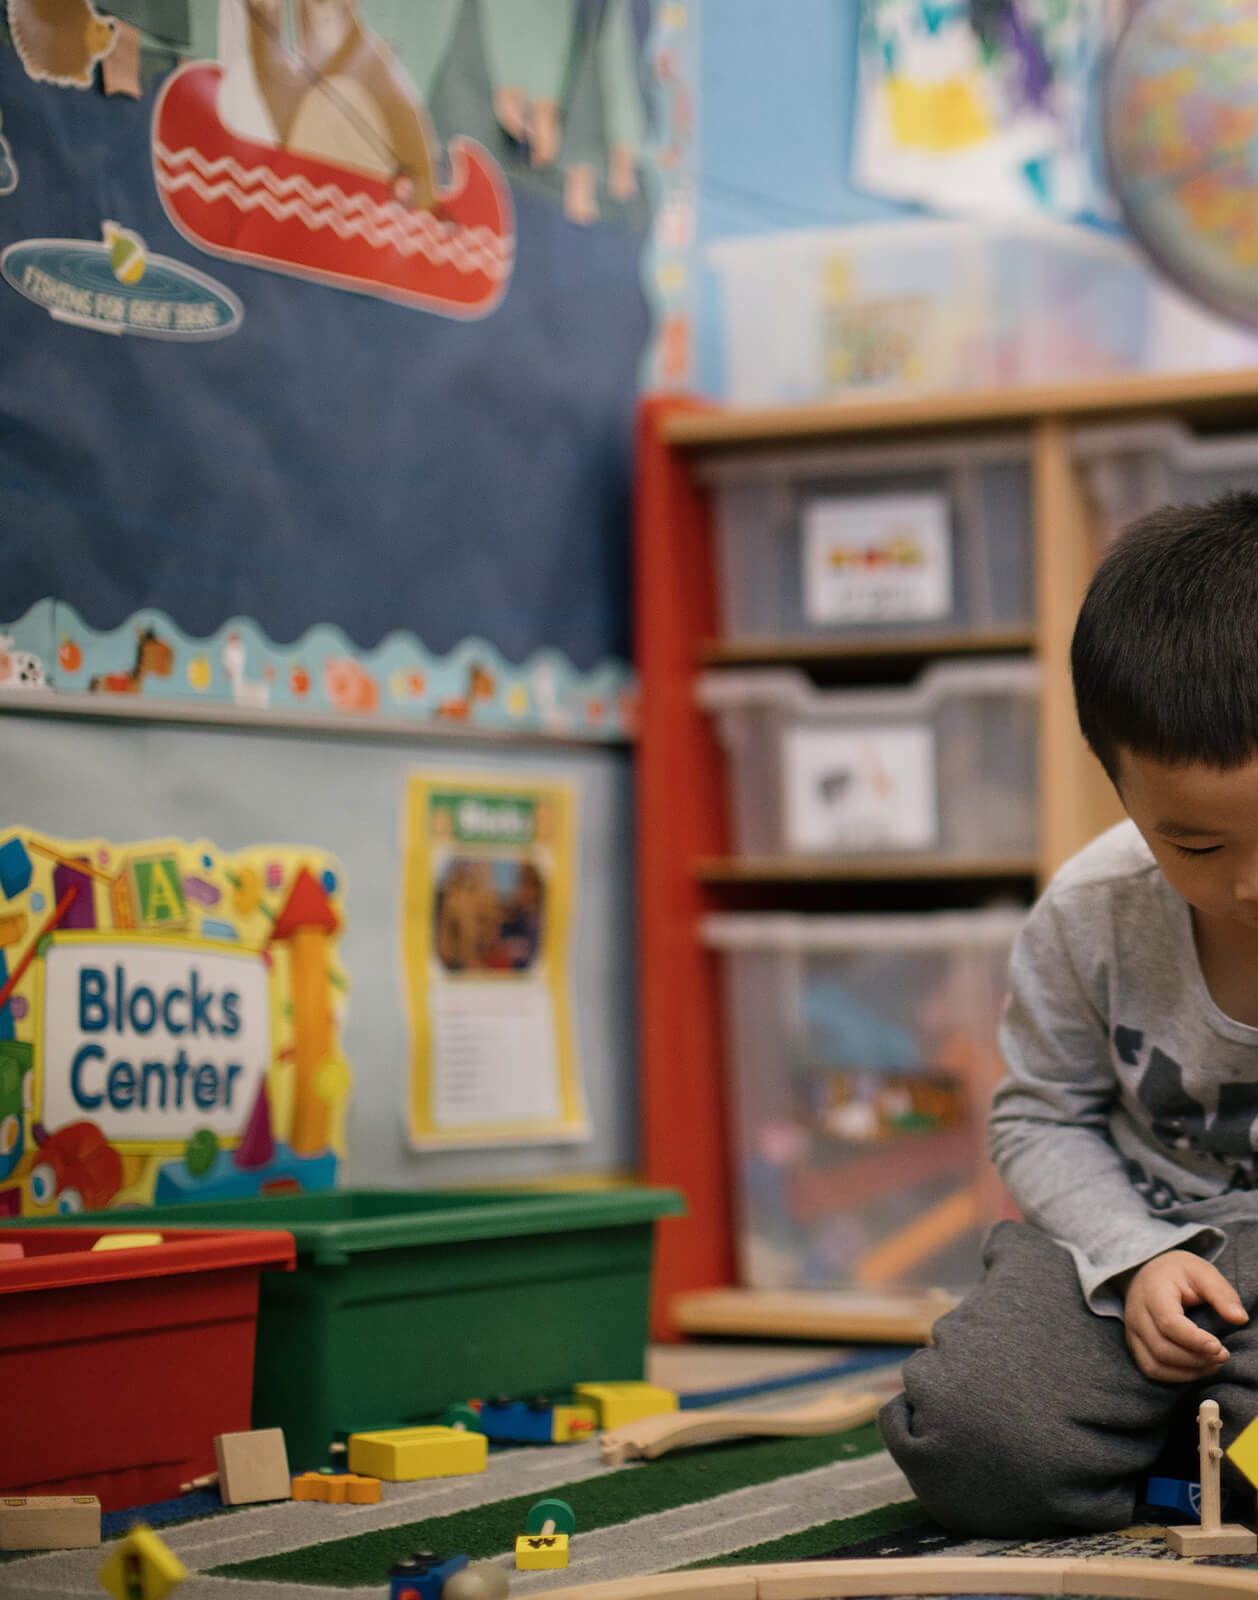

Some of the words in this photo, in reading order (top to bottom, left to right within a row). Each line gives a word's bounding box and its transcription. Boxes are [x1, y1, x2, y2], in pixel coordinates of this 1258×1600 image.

[95, 293, 125, 324] FOR
[78, 963, 242, 1036] Blocks
[70, 1043, 244, 1112] Center
